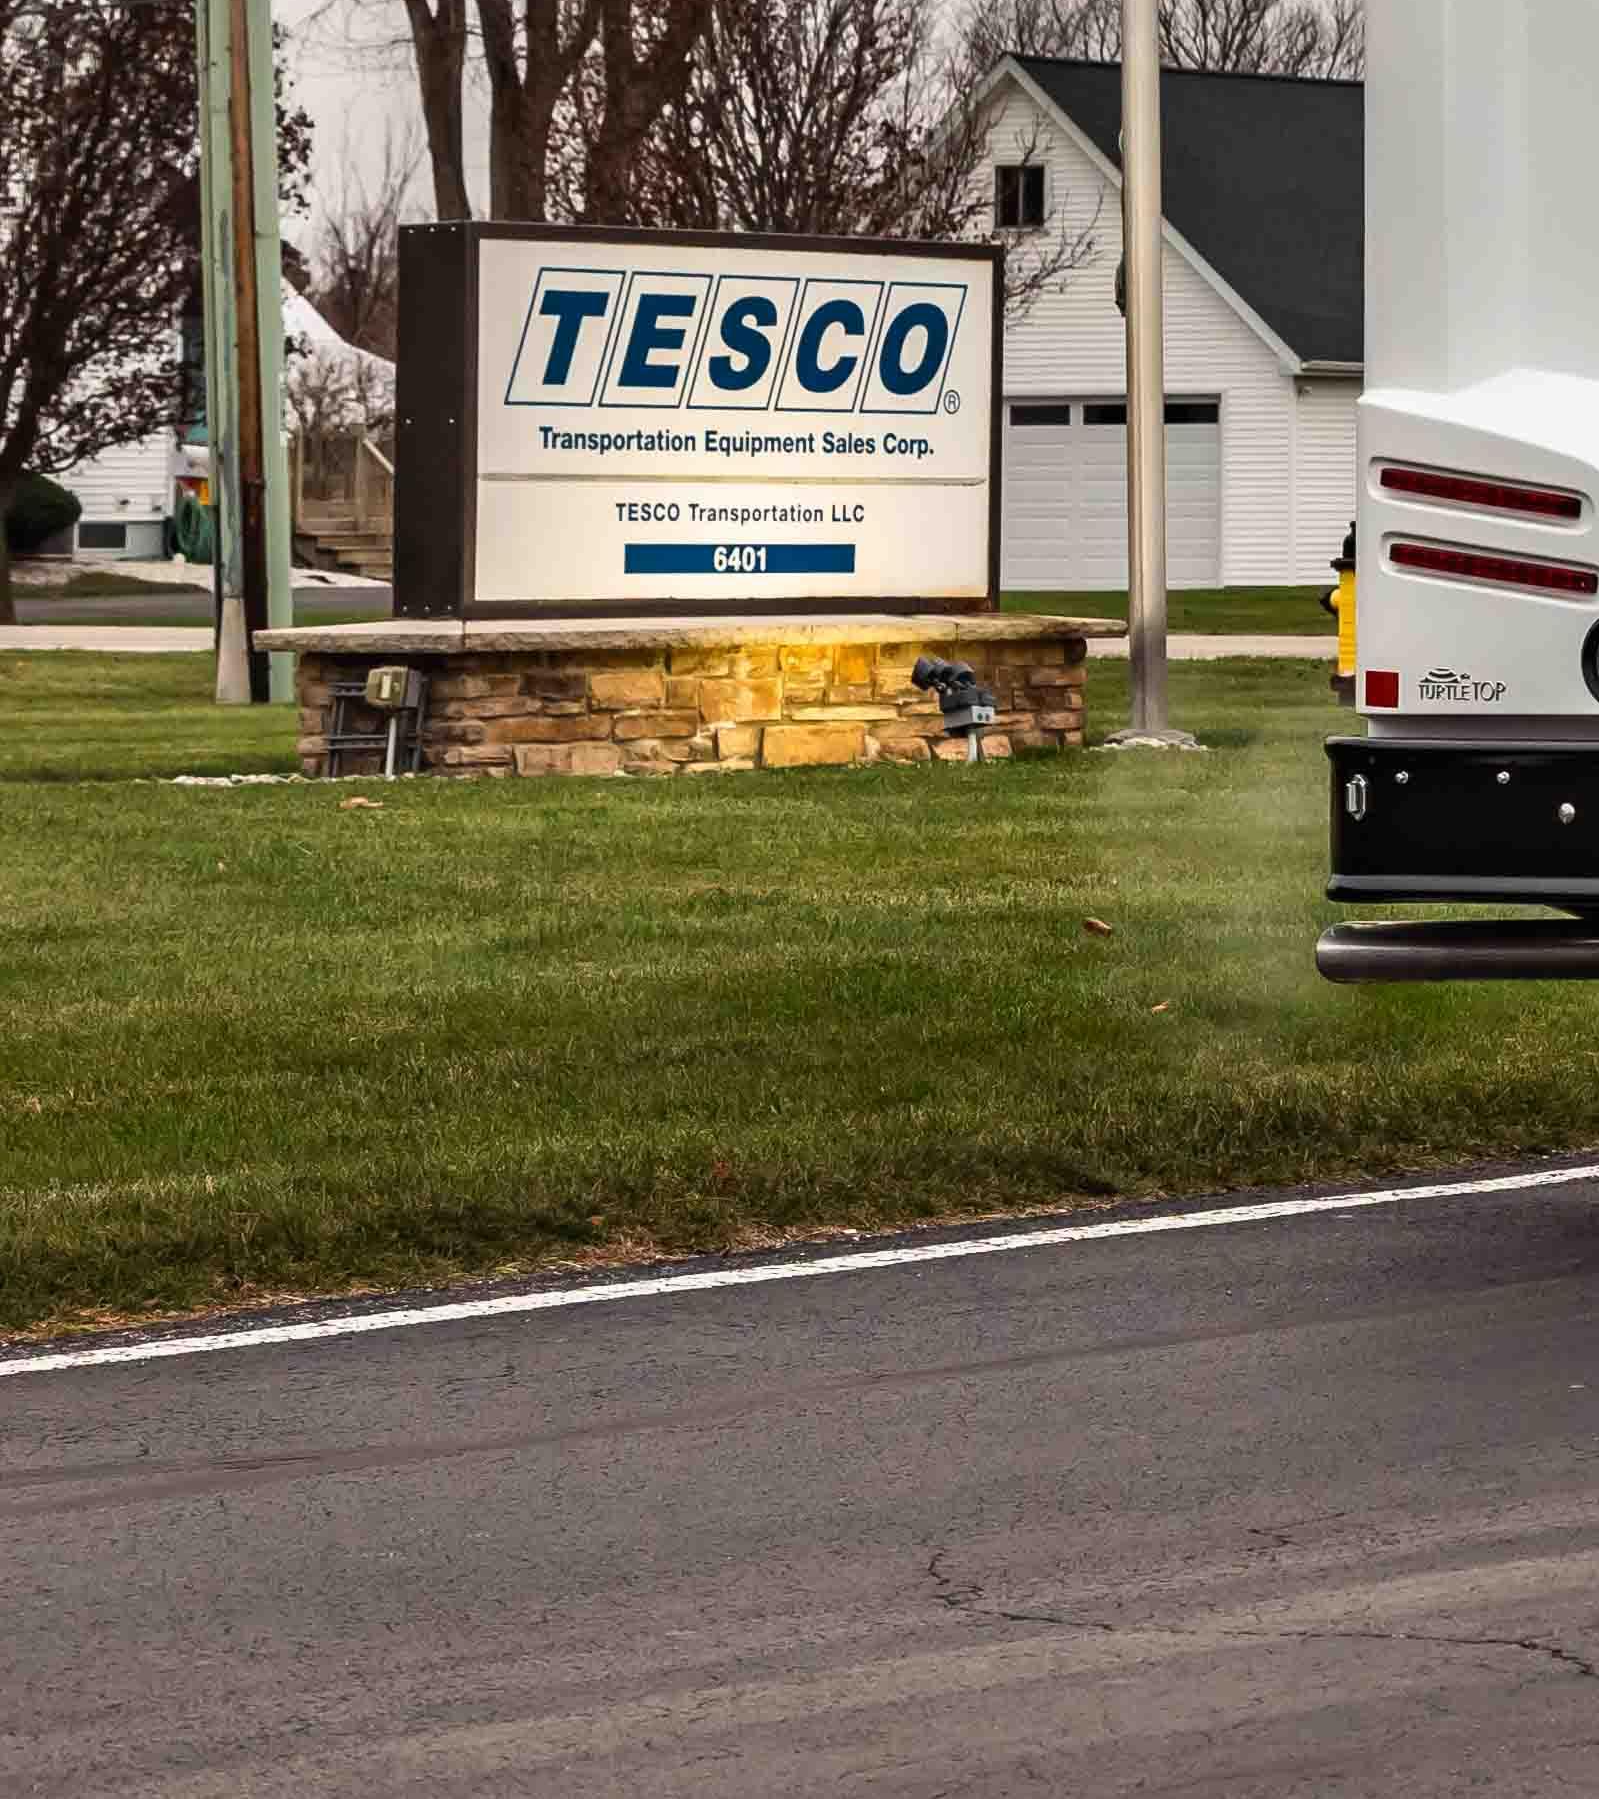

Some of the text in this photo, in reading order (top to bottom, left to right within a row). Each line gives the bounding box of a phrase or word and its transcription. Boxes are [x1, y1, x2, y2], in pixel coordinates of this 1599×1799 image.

[537, 288, 950, 396] TESCO
[538, 425, 936, 460] Transportation Equipment Sales Corp.
[614, 502, 866, 526] TESCO Transportation LLC
[712, 546, 769, 573] 6401
